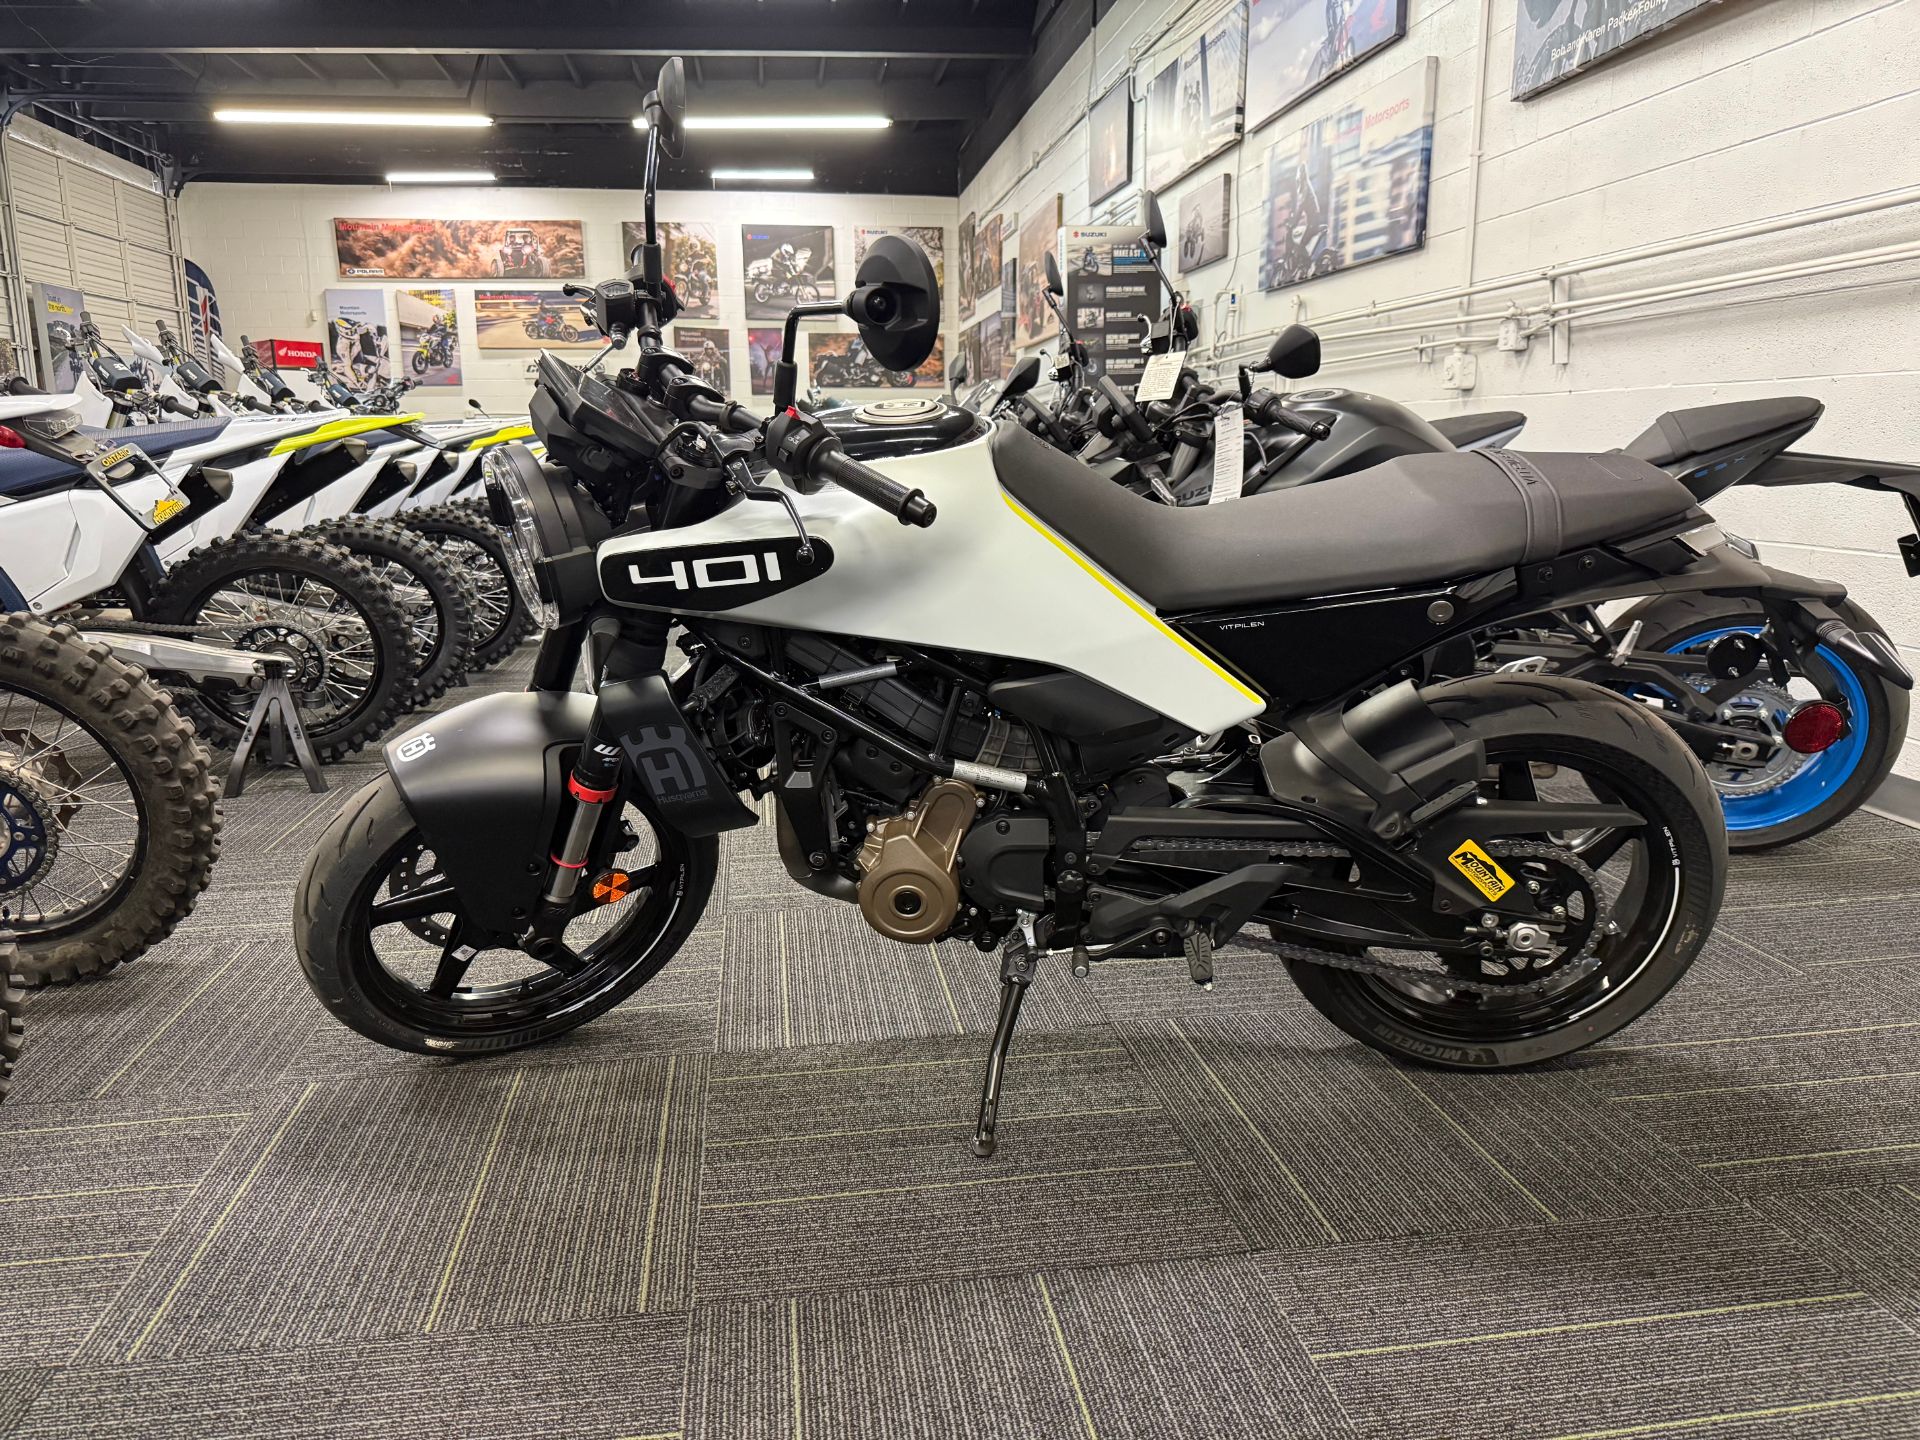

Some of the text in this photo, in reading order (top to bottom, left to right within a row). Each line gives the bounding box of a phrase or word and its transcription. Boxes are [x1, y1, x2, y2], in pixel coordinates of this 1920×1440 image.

[1551, 43, 1566, 62] Bob
[1565, 34, 1583, 53] and
[1582, 24, 1606, 43] Karen
[1607, 6, 1640, 32] Packer
[1365, 98, 1409, 129] Motorsports
[287, 350, 318, 358] HONDA
[102, 447, 131, 467] ONTARIO
[153, 500, 185, 525] MOUNTAIN
[628, 552, 782, 590] 401
[1219, 621, 1265, 630] VITPILEN
[1454, 850, 1505, 893] MOUNTAIN
[1373, 1023, 1462, 1061] MICHELIN
